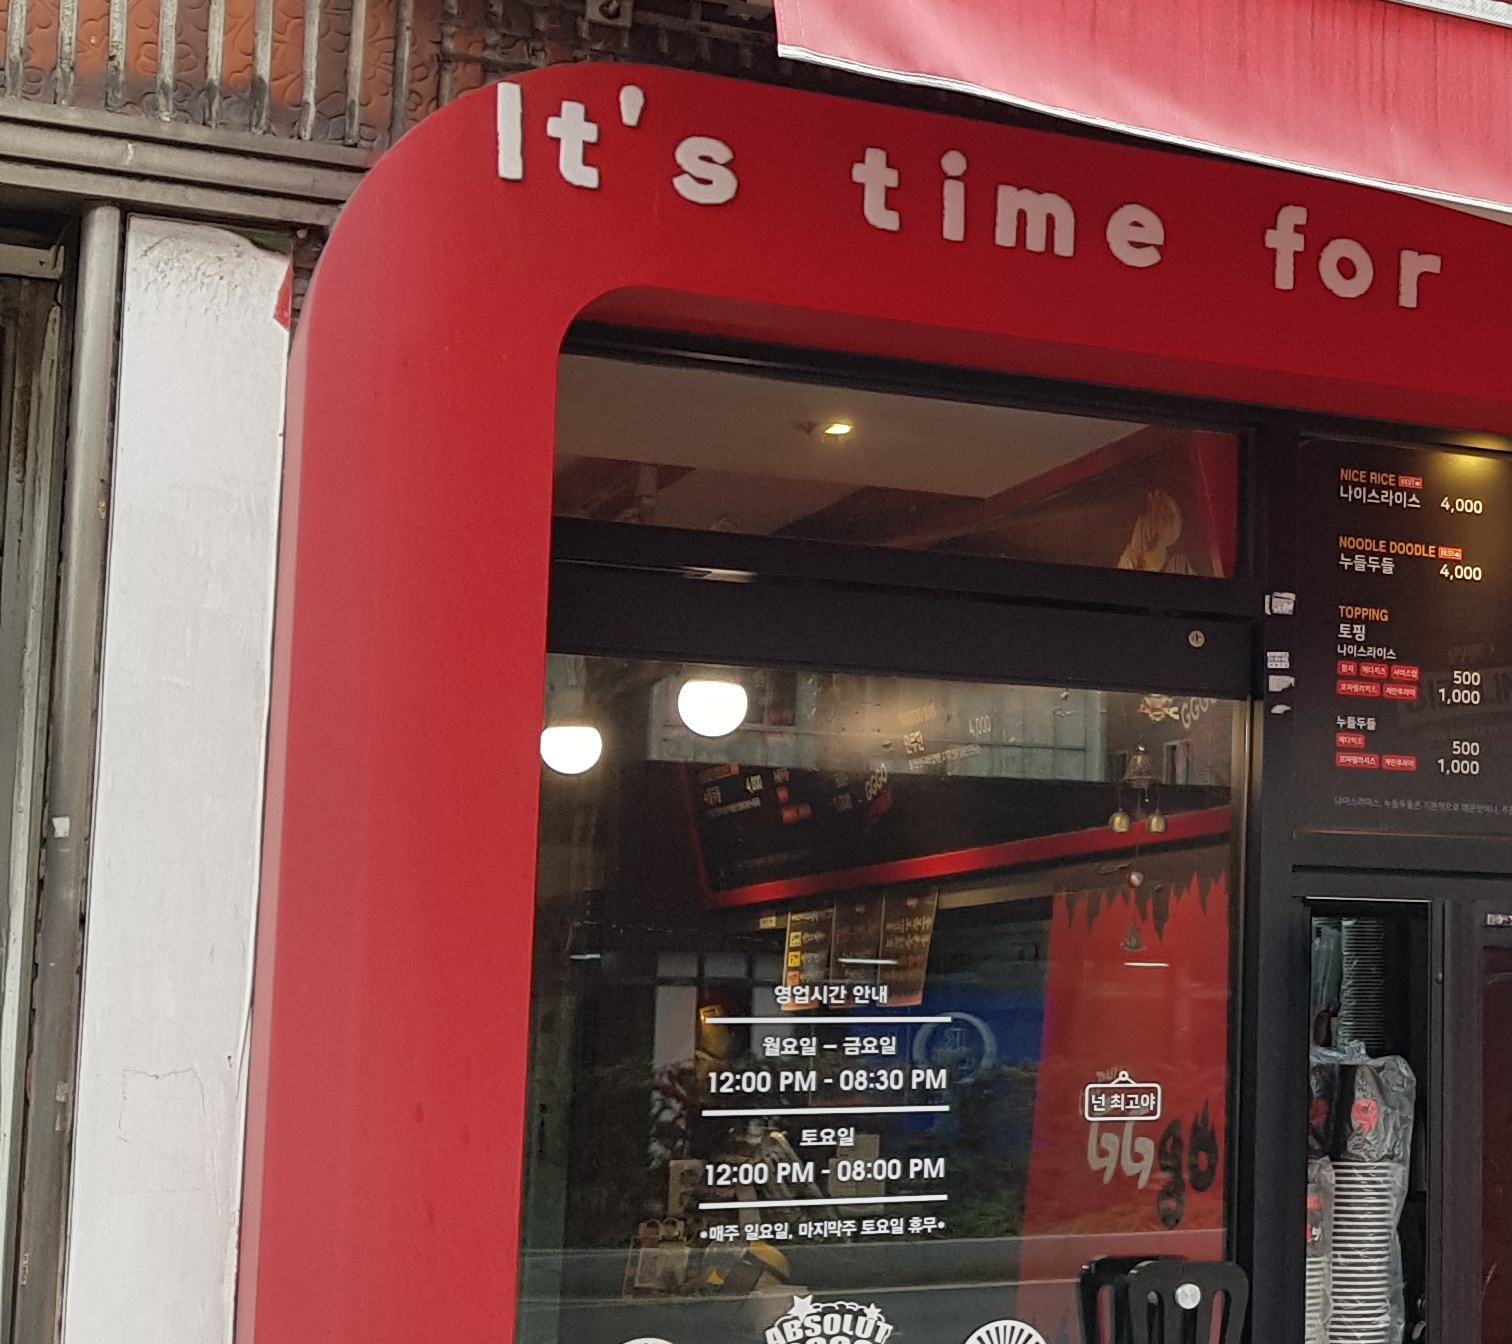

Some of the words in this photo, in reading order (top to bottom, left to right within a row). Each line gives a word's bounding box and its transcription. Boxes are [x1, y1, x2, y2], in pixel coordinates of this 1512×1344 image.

[495, 81, 739, 206] It's
[851, 147, 1166, 269] time
[1265, 204, 1442, 309] for
[1340, 468, 1367, 483] NICE
[1370, 471, 1396, 487] RICE
[1340, 485, 1421, 509] 나이스라이스
[1440, 496, 1483, 514] 4,000
[1339, 536, 1386, 553] NOODLE
[1390, 541, 1436, 558] DOODLE
[1339, 553, 1395, 575] 누들두들
[1440, 564, 1482, 581] 4,000
[1338, 605, 1389, 622] TOPPING
[1337, 623, 1366, 641] 토핑
[1337, 644, 1397, 660] 나이스라이스
[1453, 670, 1481, 686] 500
[1438, 688, 1481, 705] 1,000
[1452, 741, 1480, 756] 500
[1437, 758, 1480, 775] 1,000
[774, 985, 847, 1004] 영업시간
[853, 985, 888, 1004] 안내
[762, 1037, 817, 1056] 월요일
[842, 1036, 896, 1055] 금요일
[708, 1071, 771, 1093] 12:00
[779, 1071, 817, 1092] PM
[839, 1069, 903, 1091] 08:30
[911, 1069, 947, 1089] PM
[1091, 1094, 1106, 1112] 넌
[1110, 1093, 1156, 1112] 최고야
[800, 1127, 855, 1146] 토요일
[705, 1163, 769, 1186] 12:00
[777, 1162, 814, 1183] PM
[837, 1159, 901, 1182] 08:00
[909, 1158, 945, 1179] PM
[799, 1220, 857, 1238] 마지막주
[860, 1218, 904, 1235] 토요일
